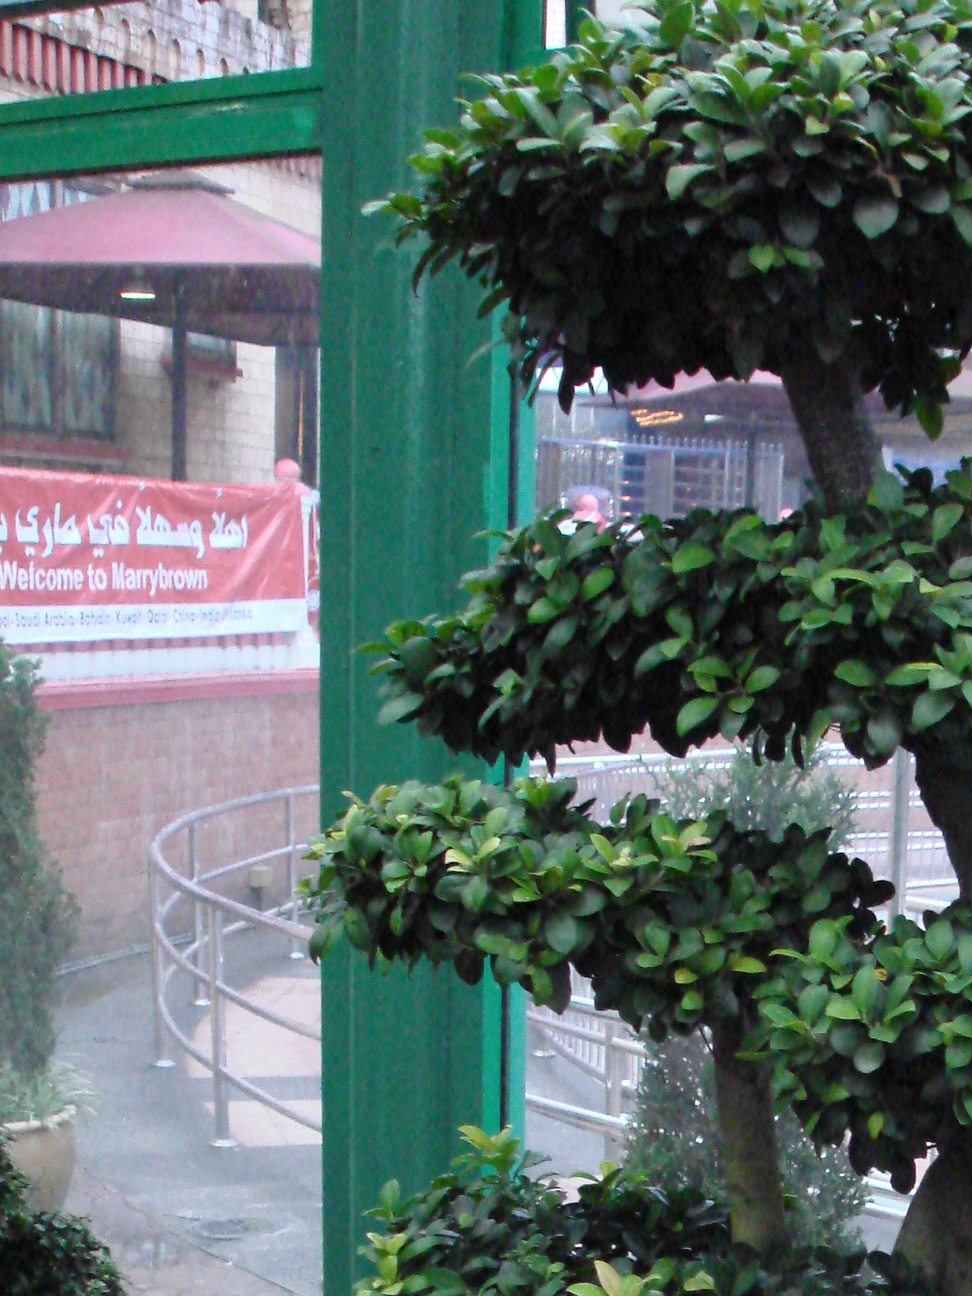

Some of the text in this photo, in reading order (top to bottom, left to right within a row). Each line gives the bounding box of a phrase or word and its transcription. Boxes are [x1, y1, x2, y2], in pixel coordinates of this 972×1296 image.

[15, 501, 82, 558] ماري
[86, 500, 131, 558] في
[0, 561, 209, 597] Welcome to Marrybrown
[44, 610, 75, 626] Arabia
